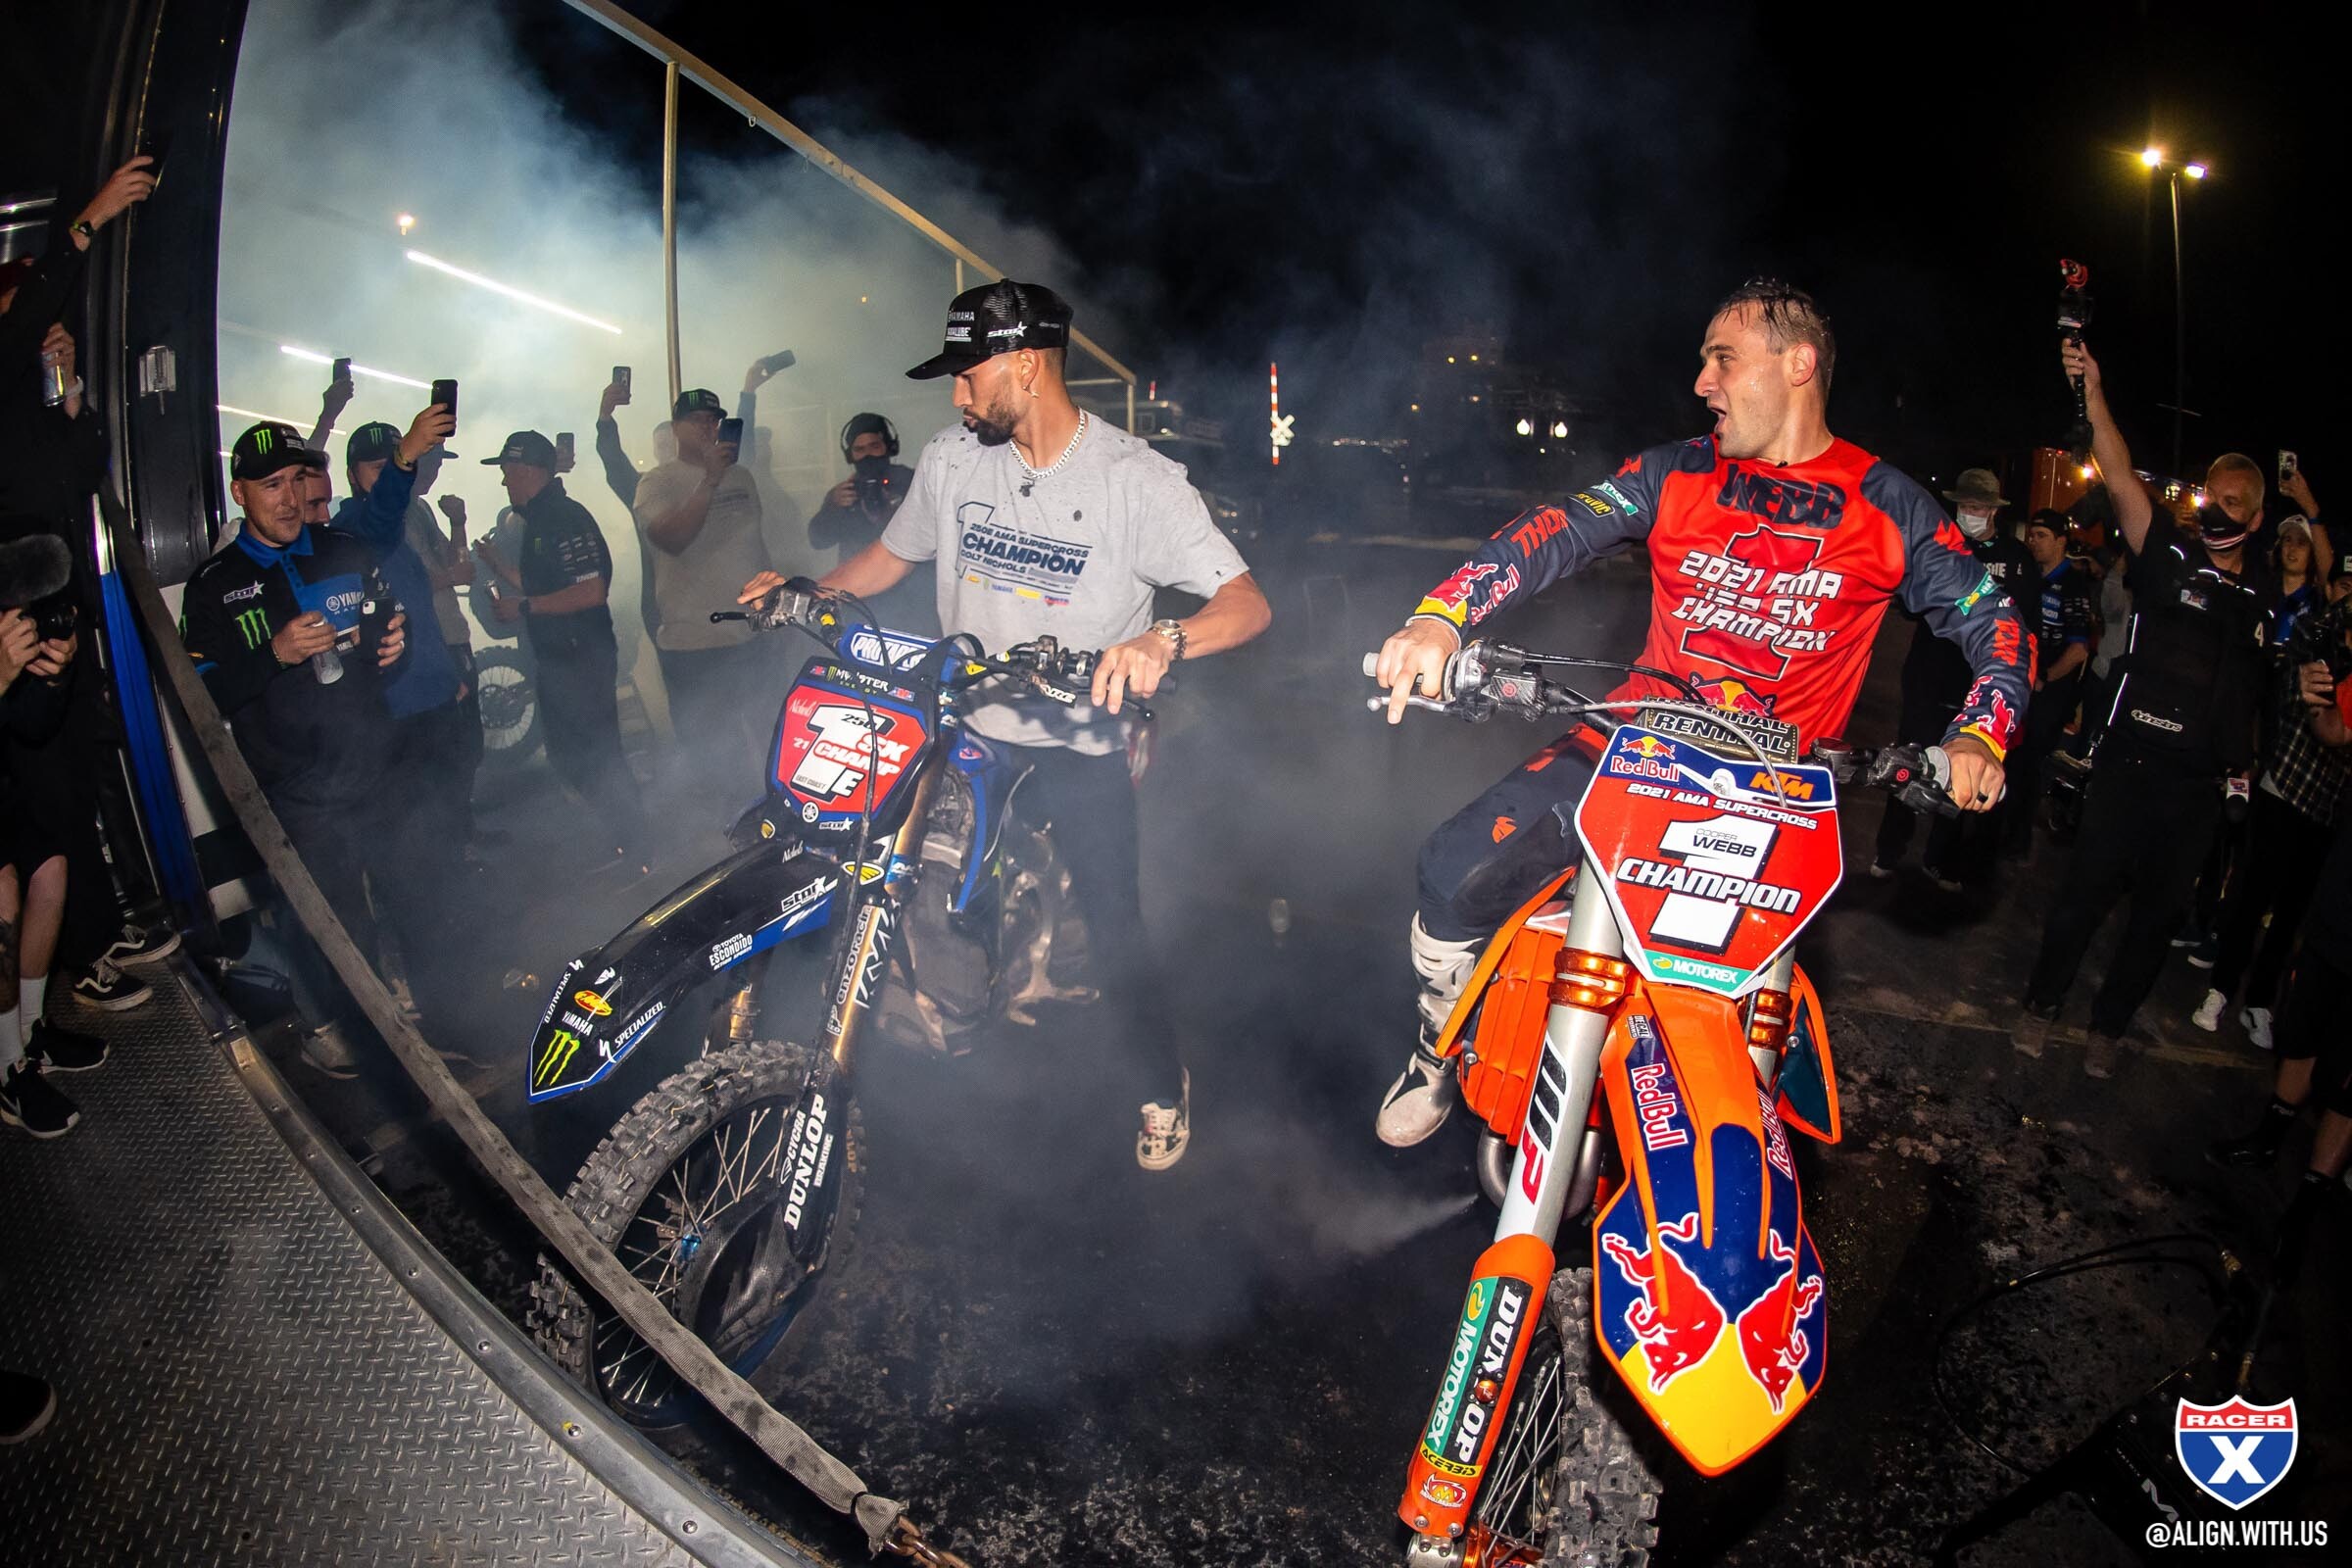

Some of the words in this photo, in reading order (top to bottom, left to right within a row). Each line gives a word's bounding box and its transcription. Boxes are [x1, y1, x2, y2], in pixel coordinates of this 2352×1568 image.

[1716, 464, 1847, 529] WEBB
[962, 532, 1086, 576] CHAMPION
[995, 530, 1017, 543] AMA
[1017, 536, 1090, 559] SUPERCROSS
[959, 549, 982, 563] COLT
[983, 557, 1027, 574] NICHOLS
[1678, 550, 1765, 594] 2021
[1765, 568, 1844, 599] AMA
[1670, 596, 1838, 652] CHAMPION
[1769, 599, 1820, 626] SX
[814, 741, 901, 776] CHAMP
[858, 733, 910, 762] SX
[830, 769, 866, 798] E
[1749, 770, 1815, 801] KTM
[1627, 782, 1671, 800] 2021
[1672, 790, 1711, 807] AMA
[1712, 799, 1818, 831] SUPERCROSS
[1692, 835, 1758, 858] WEBB
[1695, 828, 1739, 841] COOPER
[1616, 857, 1802, 915] CHAMPION
[709, 934, 754, 967] ESCONDIDO
[720, 933, 745, 950] TOYOTA
[1672, 958, 1739, 985] MOTOREX
[562, 1010, 594, 1037] YAMAHA
[787, 1109, 807, 1160] CYCRA
[784, 1093, 828, 1231] DUNLOP
[1425, 1319, 1479, 1450] MOTOREX
[1447, 1285, 1524, 1465] DUNOP
